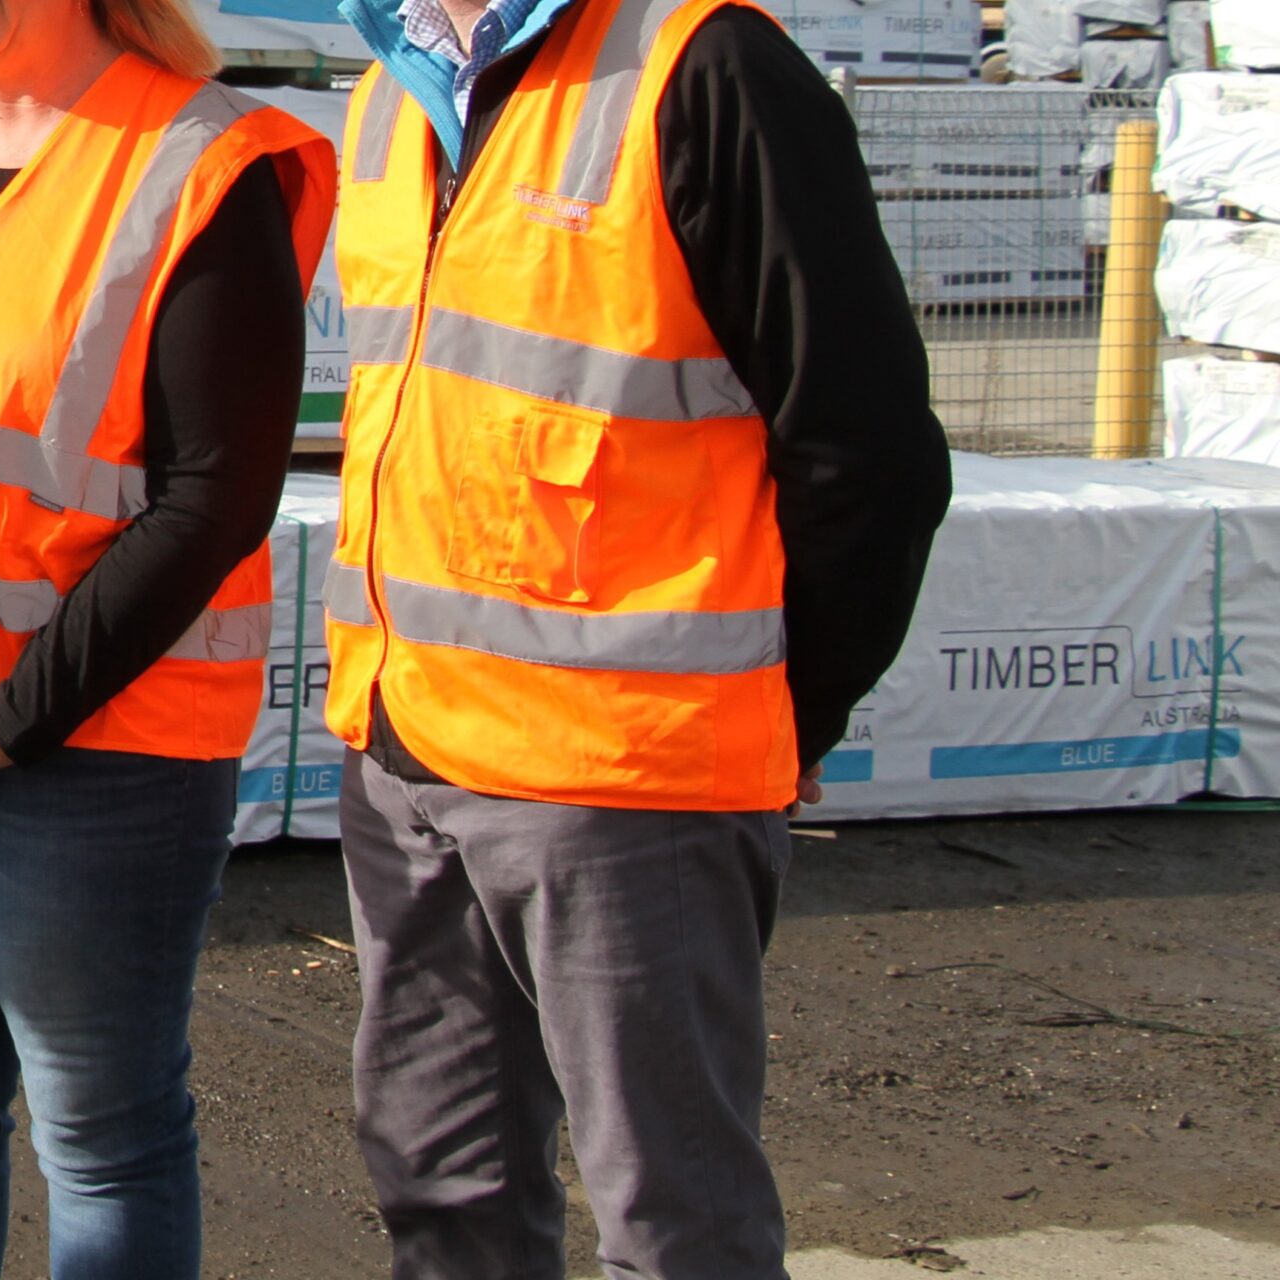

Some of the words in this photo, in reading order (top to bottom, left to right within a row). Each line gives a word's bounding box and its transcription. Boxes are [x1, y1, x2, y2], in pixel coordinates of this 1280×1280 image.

[885, 18, 943, 34] TIMBER
[940, 643, 1120, 691] TIMBER
[1147, 635, 1246, 682] LINK
[1061, 744, 1115, 766] BLUE
